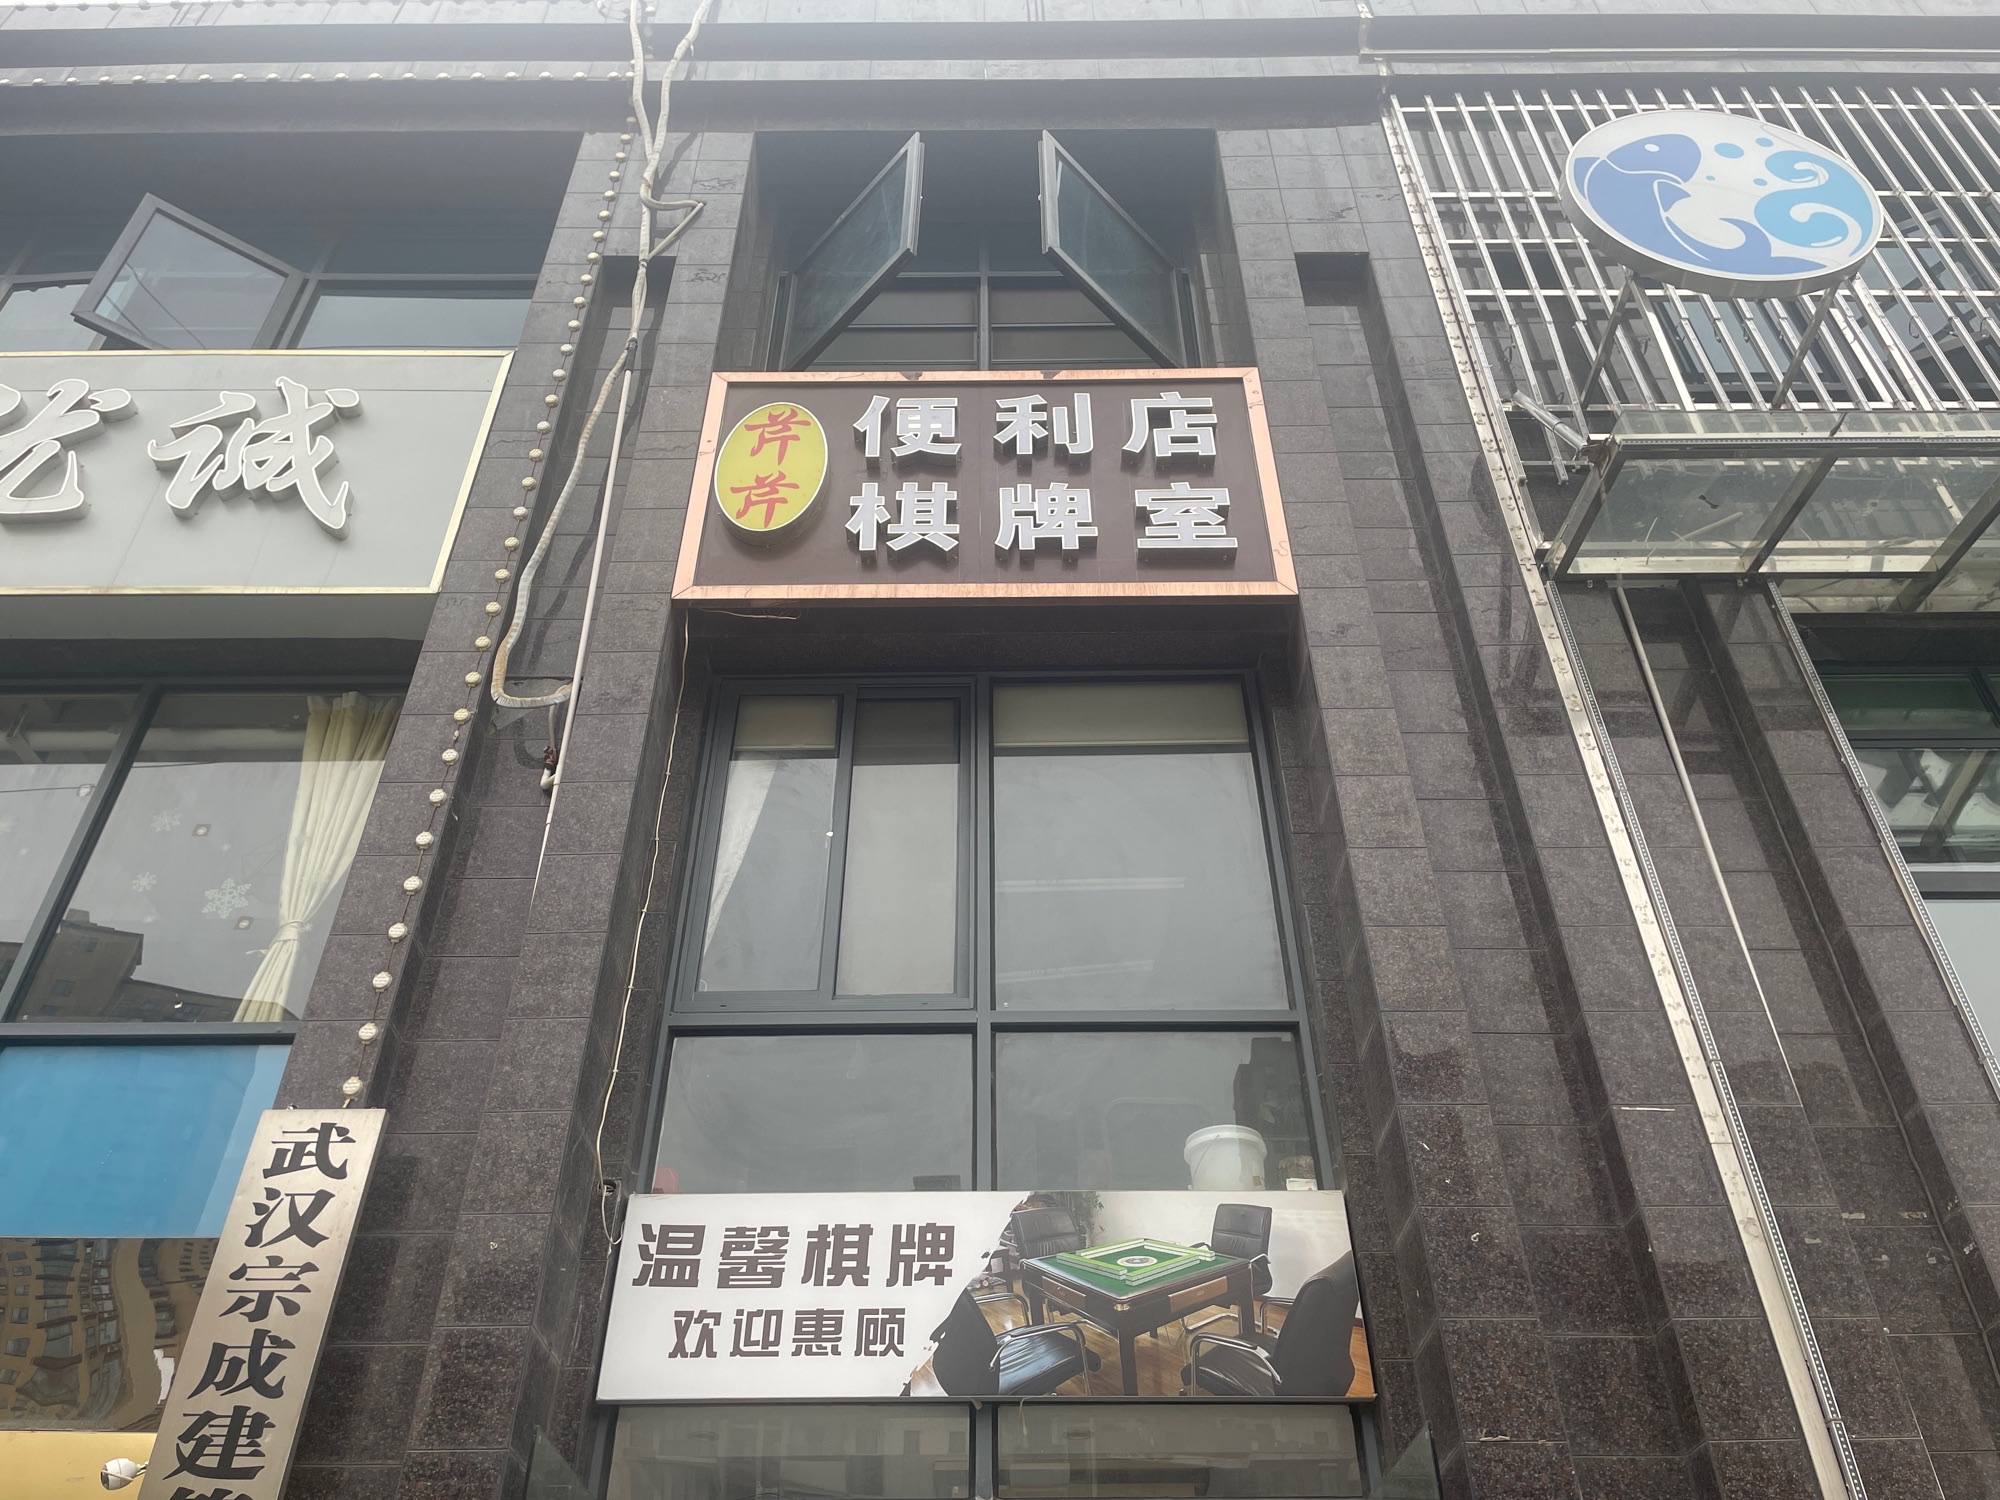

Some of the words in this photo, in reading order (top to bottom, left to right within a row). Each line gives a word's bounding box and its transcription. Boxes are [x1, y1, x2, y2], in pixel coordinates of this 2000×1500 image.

[853, 391, 1218, 463] 便利店
[729, 407, 812, 530] 芹芹
[844, 482, 1239, 557] 棋牌室
[631, 1222, 956, 1290] 温馨棋牌
[667, 1307, 907, 1360] 欢迎惠顾
